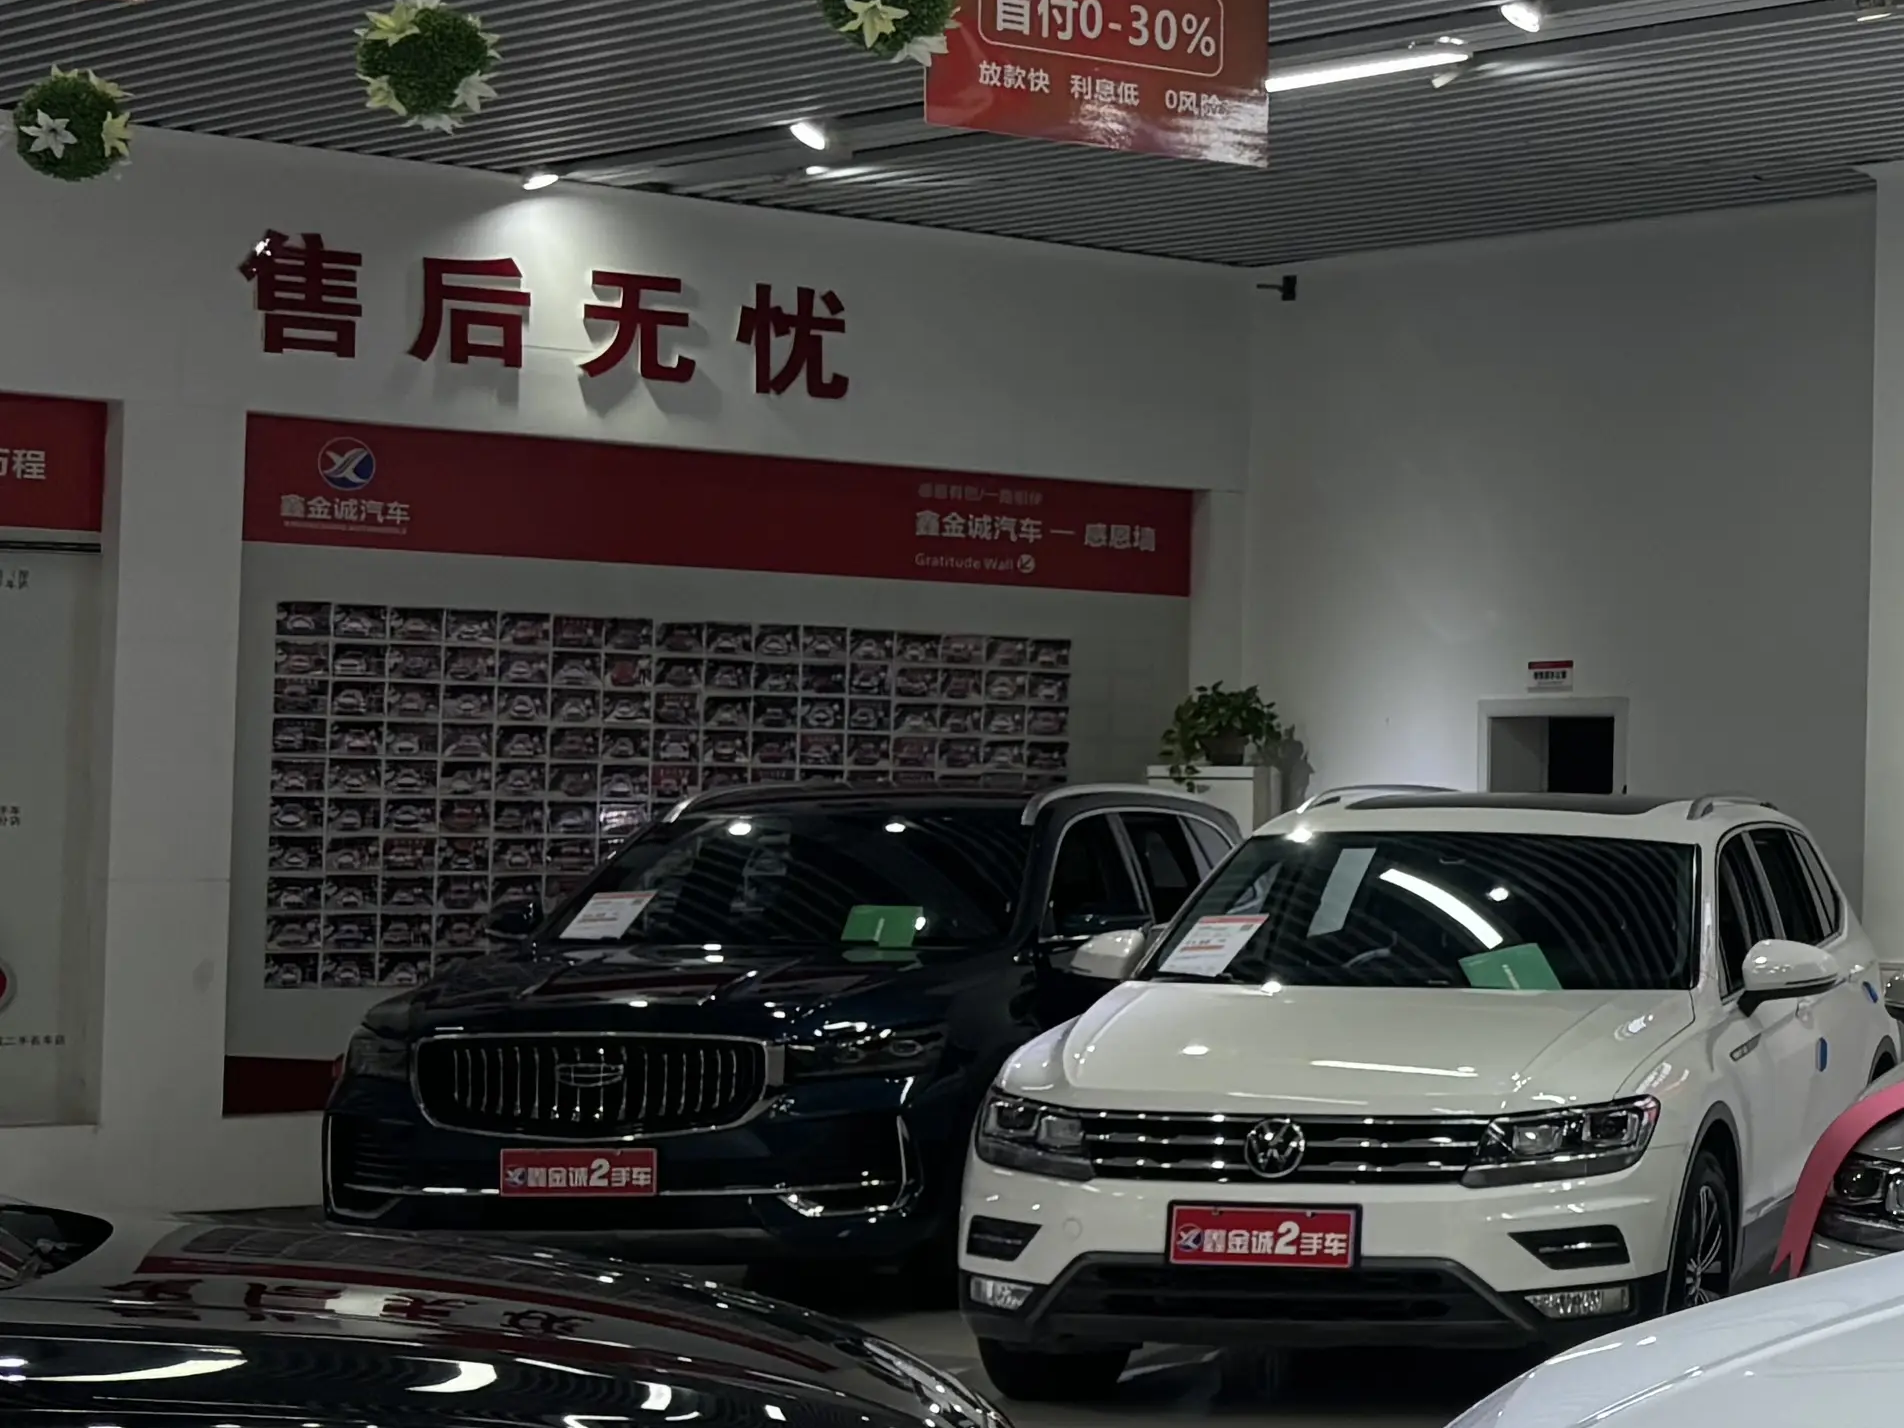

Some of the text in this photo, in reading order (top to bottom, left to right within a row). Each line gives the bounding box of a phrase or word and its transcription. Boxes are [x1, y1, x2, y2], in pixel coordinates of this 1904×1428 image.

[978, 60, 1050, 94] 放款快
[1070, 74, 1139, 107] 利息低
[239, 229, 849, 400] 售后无忧
[914, 553, 1014, 572] Gratitude Wall
[1203, 1220, 1347, 1257] 鑫金诚2手车
